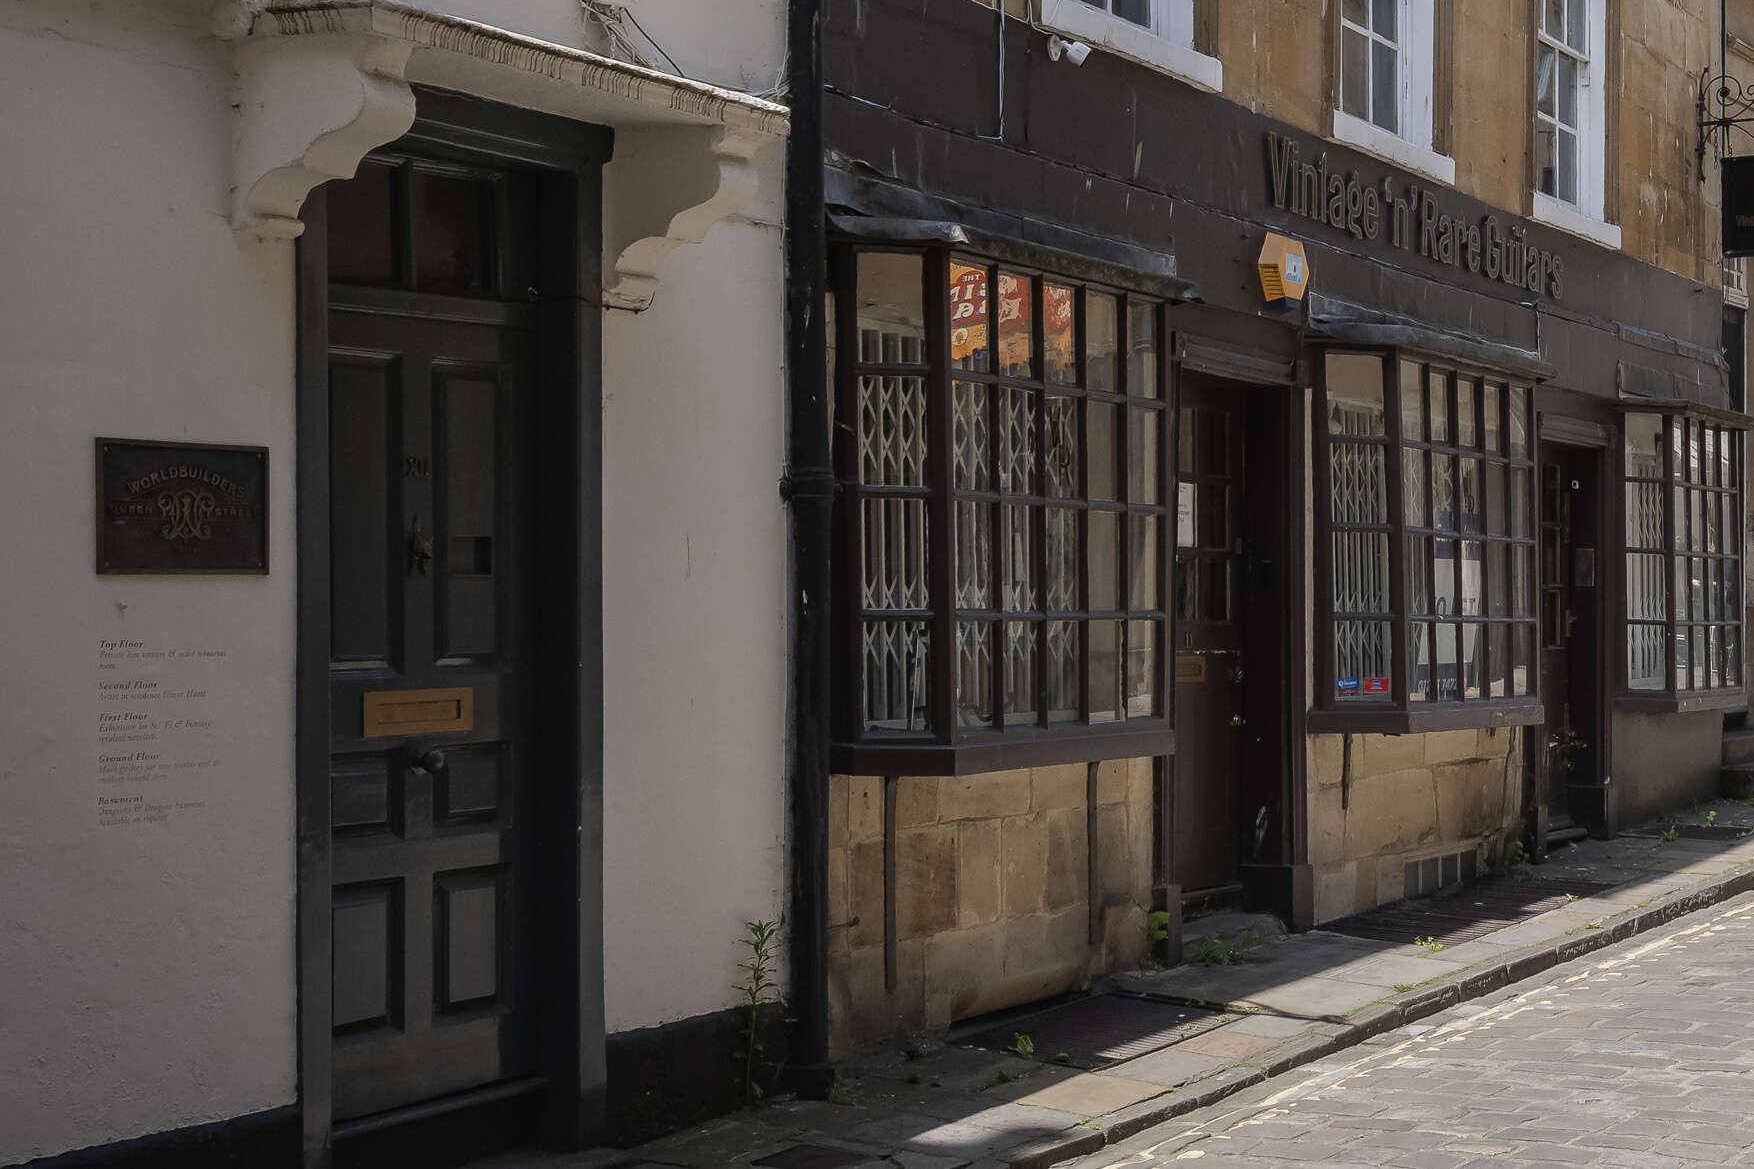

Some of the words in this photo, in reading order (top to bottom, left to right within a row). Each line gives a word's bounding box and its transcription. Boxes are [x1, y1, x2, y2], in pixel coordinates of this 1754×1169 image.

[1265, 132, 1380, 240] Vintage
[1422, 189, 1481, 272] Rare
[1485, 214, 1565, 301] Guitars
[127, 464, 247, 497] WORLDBUILDERS
[98, 639, 118, 649] Top
[119, 639, 144, 648] Floor
[98, 680, 132, 690] Second
[133, 680, 158, 689] Floor
[99, 713, 122, 722] First
[123, 712, 149, 721] Floor
[98, 754, 134, 763] Ground
[136, 752, 160, 761] Floor
[98, 796, 144, 806] Basement
